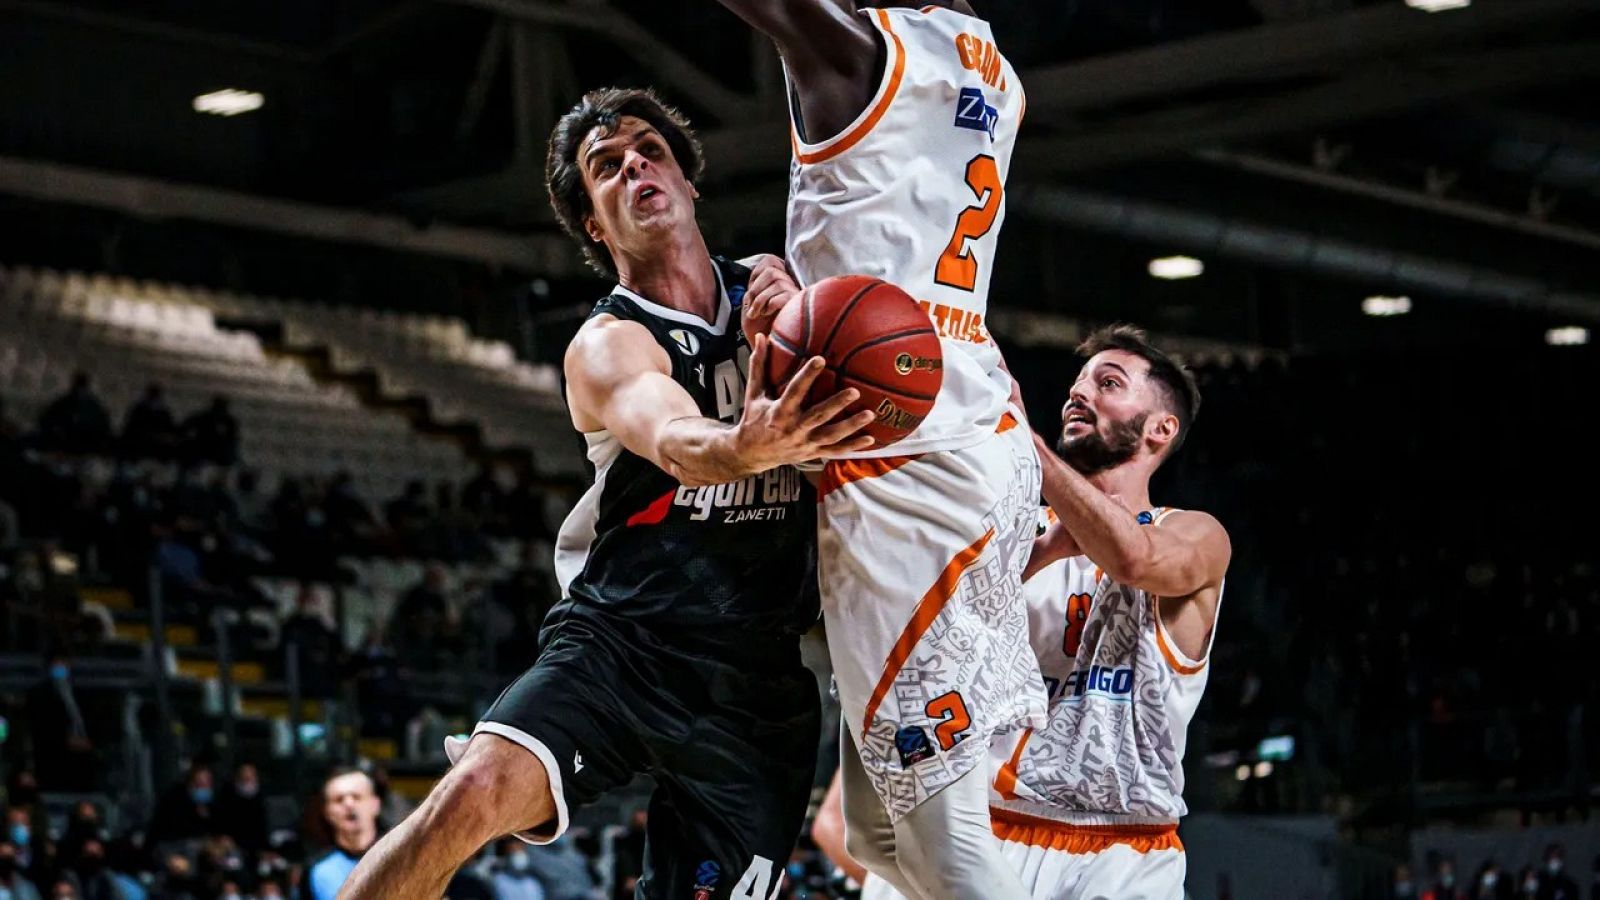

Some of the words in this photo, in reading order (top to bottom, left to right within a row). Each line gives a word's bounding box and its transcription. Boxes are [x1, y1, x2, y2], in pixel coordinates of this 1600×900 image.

[934, 153, 1005, 293] 2
[723, 507, 786, 524] ZANETTI
[1063, 592, 1093, 657] 8
[925, 690, 973, 752] 2
